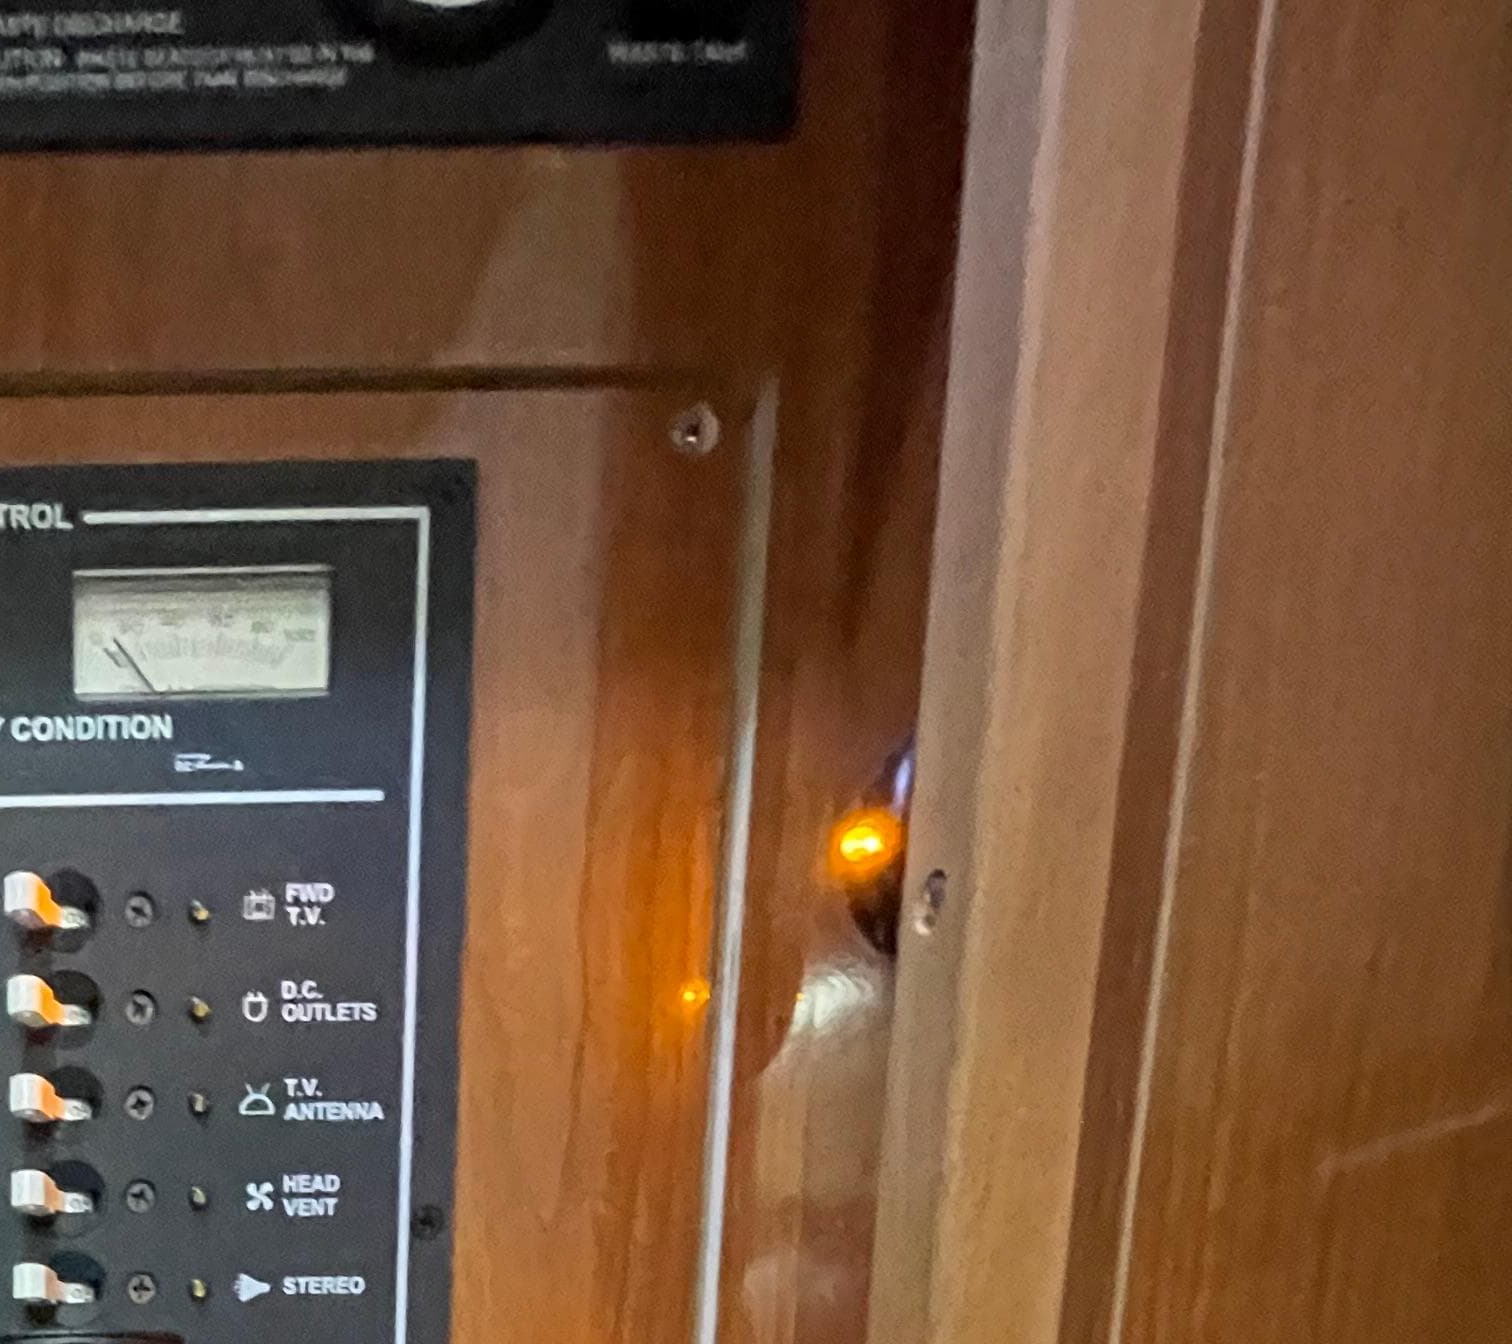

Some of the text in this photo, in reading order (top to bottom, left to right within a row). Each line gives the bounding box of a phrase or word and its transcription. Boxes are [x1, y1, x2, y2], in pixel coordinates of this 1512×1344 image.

[11, 715, 174, 741] CONDITION
[286, 882, 335, 903] FWD
[281, 1002, 377, 1022] OUTLETS
[283, 1102, 385, 1120] ANTENNA
[282, 1174, 341, 1193] HEAD
[282, 1198, 338, 1217] VENT
[282, 1276, 366, 1295] STEREO
